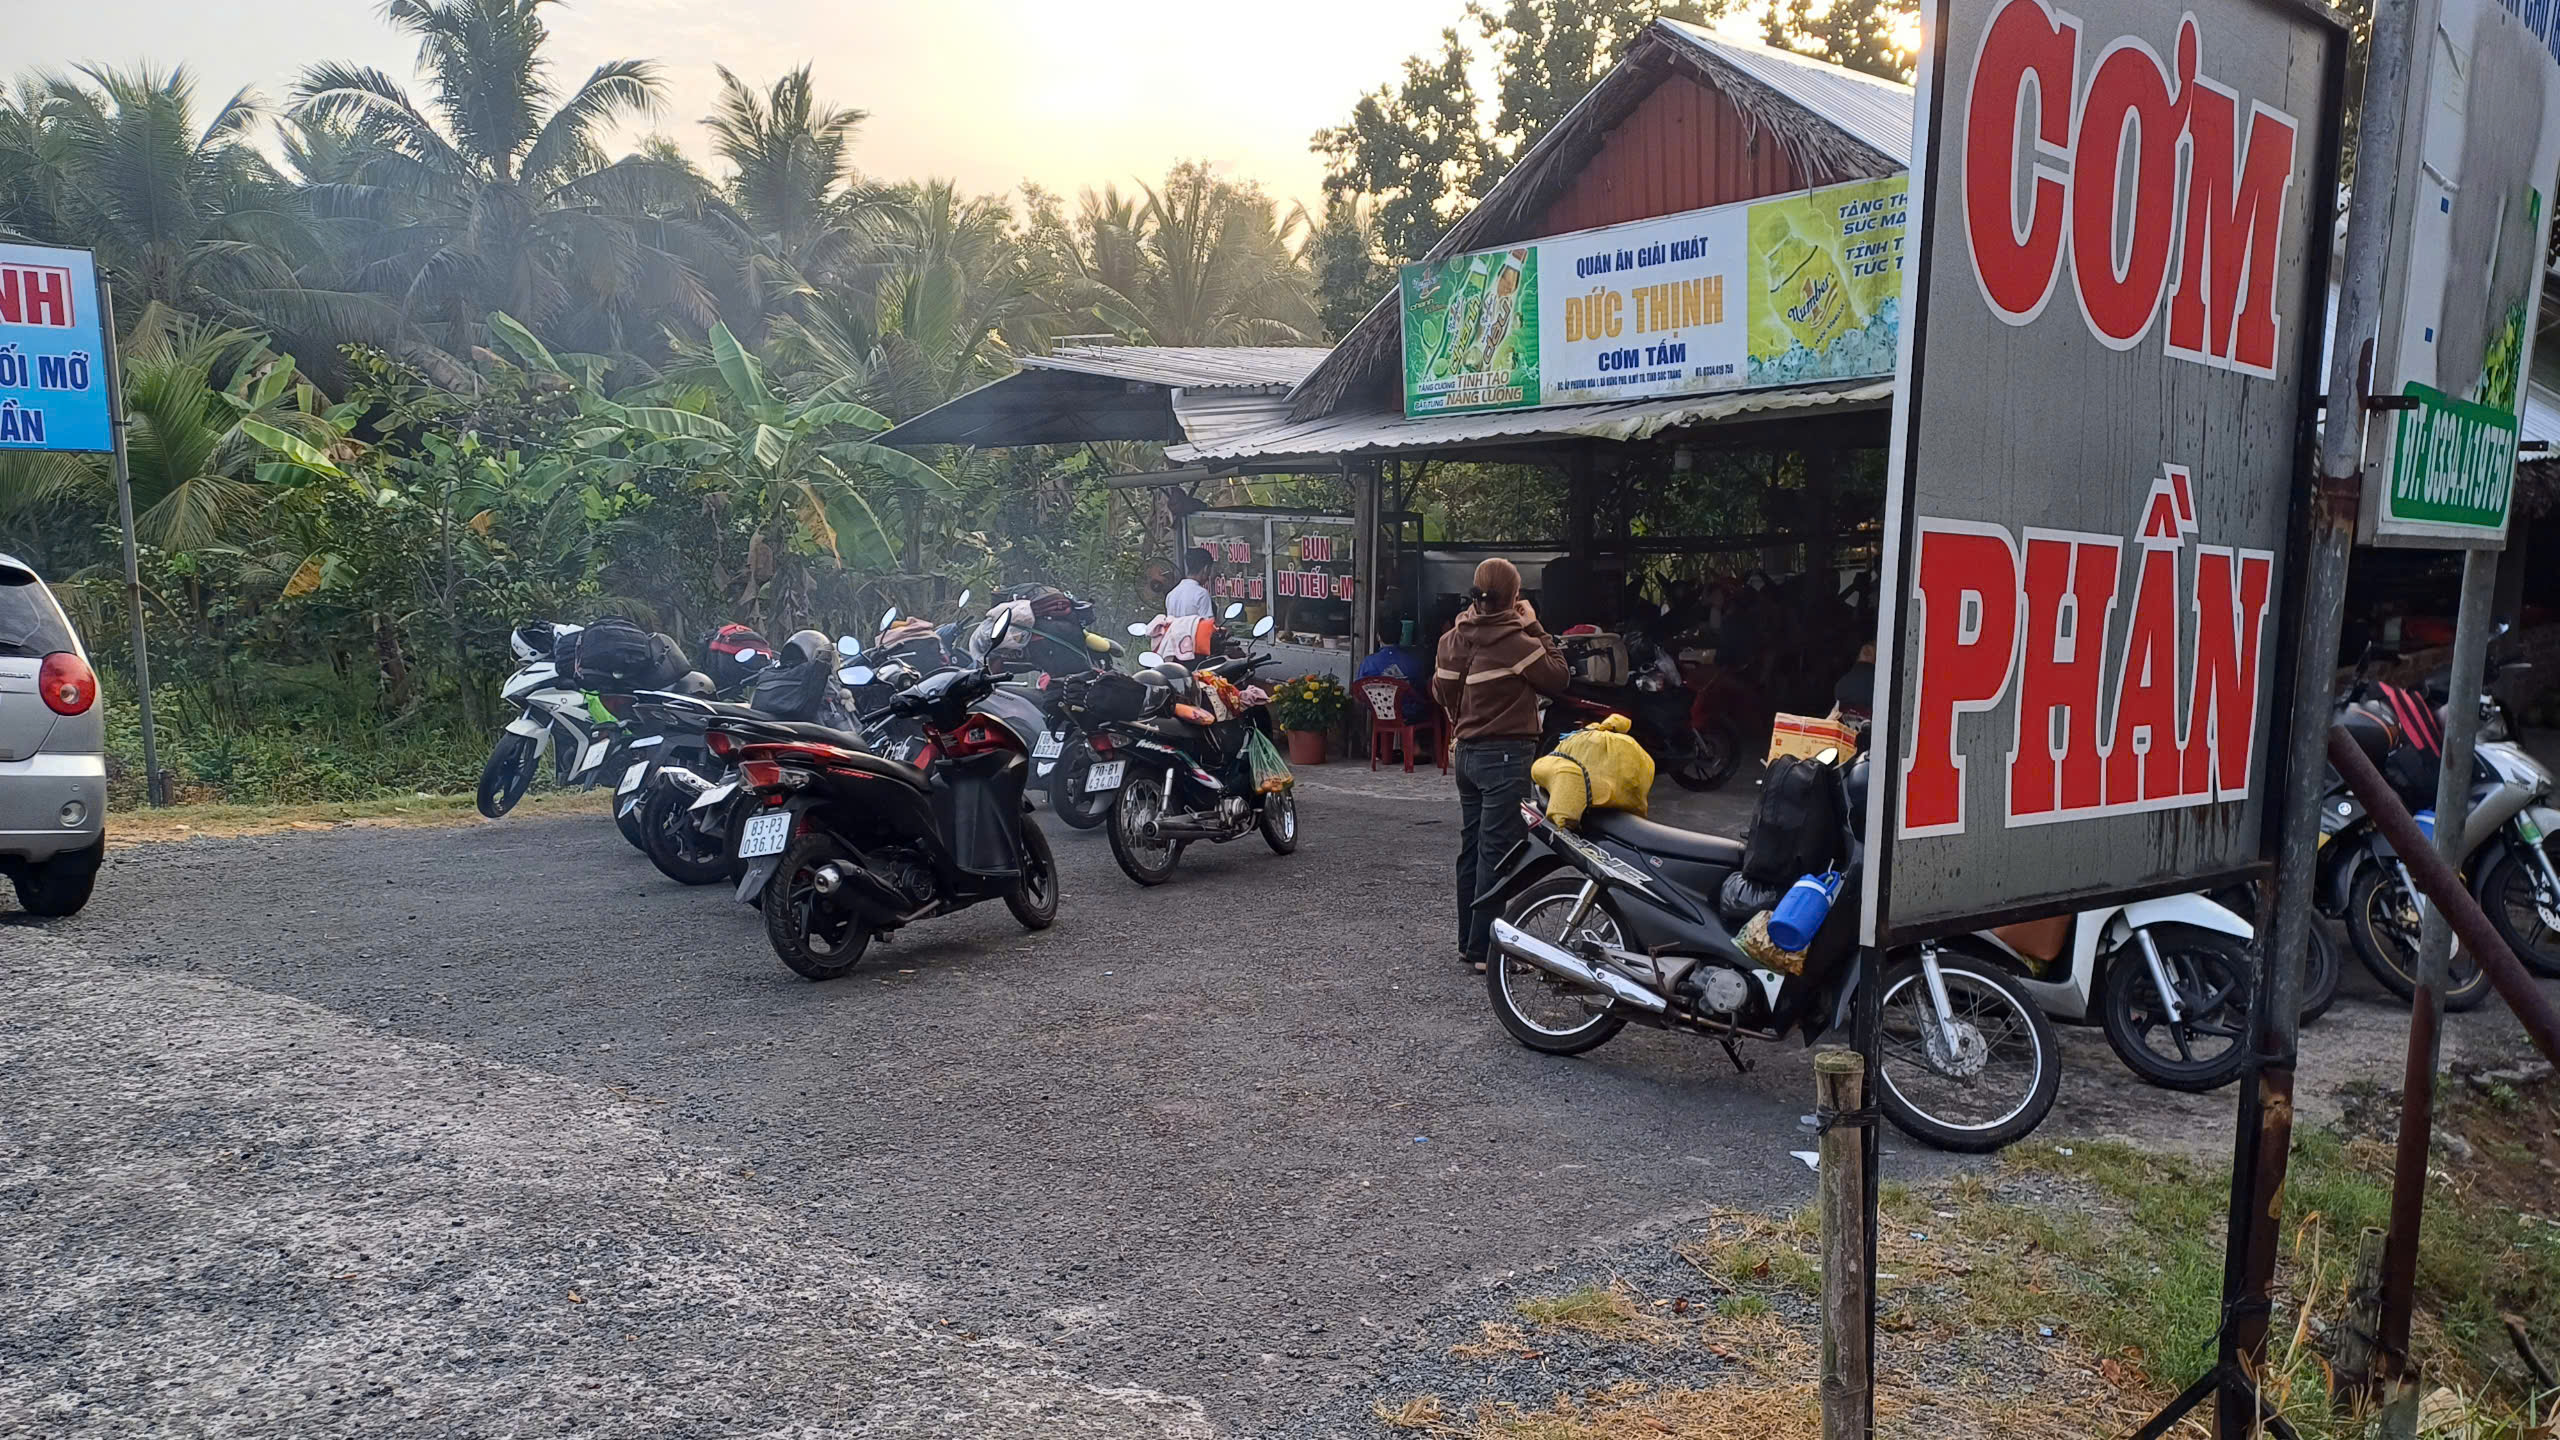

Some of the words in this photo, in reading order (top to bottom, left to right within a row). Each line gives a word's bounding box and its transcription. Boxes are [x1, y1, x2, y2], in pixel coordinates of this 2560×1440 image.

[1962, 0, 2298, 380] CƠM
[1576, 252, 1611, 278] QUÁN
[1615, 249, 1633, 271] ĂN
[1638, 241, 1666, 268] GIẢI
[1671, 235, 1708, 262] KHÁT
[1565, 286, 1623, 343] ĐỨC
[1632, 275, 1723, 338] THỊNH
[1787, 272, 1835, 323] Number
[38, 351, 89, 390] MỠ
[1598, 348, 1640, 371] CƠM
[1645, 339, 1687, 366] TẤM
[1302, 531, 1331, 562] BÚN
[1278, 562, 1297, 597] HỦ
[1298, 565, 1329, 600] TIẾU
[1899, 463, 2274, 840] PHẦN
[1094, 762, 1119, 778] 70-B1
[743, 834, 784, 855] 036.12
[751, 816, 784, 837] 83-P3
